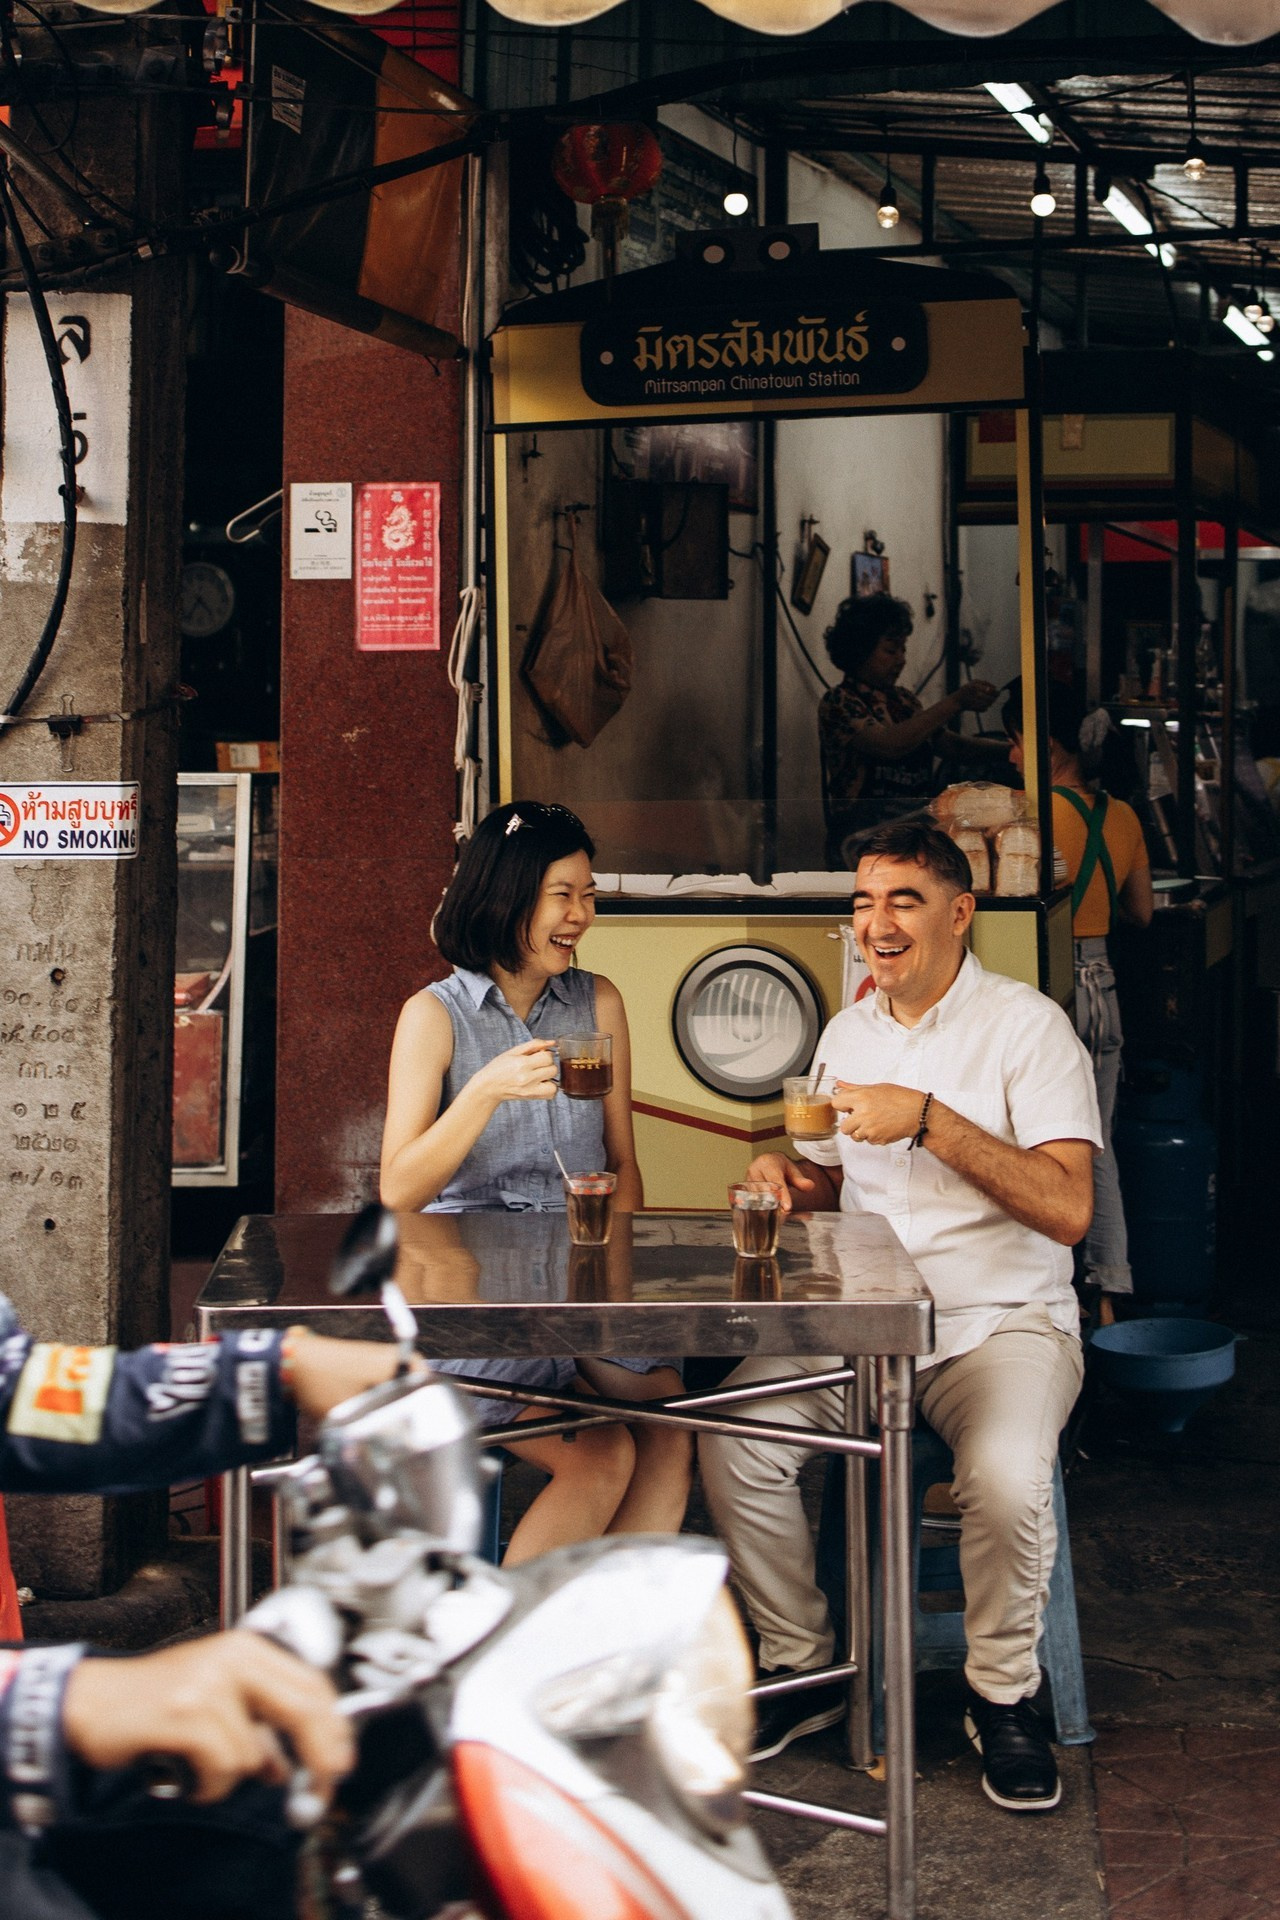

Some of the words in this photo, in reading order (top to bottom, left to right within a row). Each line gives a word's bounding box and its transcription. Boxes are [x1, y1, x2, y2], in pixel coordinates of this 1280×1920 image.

[633, 309, 870, 372] มิตรสัมพันธ์
[644, 378, 726, 395] Mitrsampan
[730, 373, 803, 391] Chinatown
[808, 369, 861, 387] Station
[23, 829, 49, 849] NO
[57, 829, 137, 849] SMOKING
